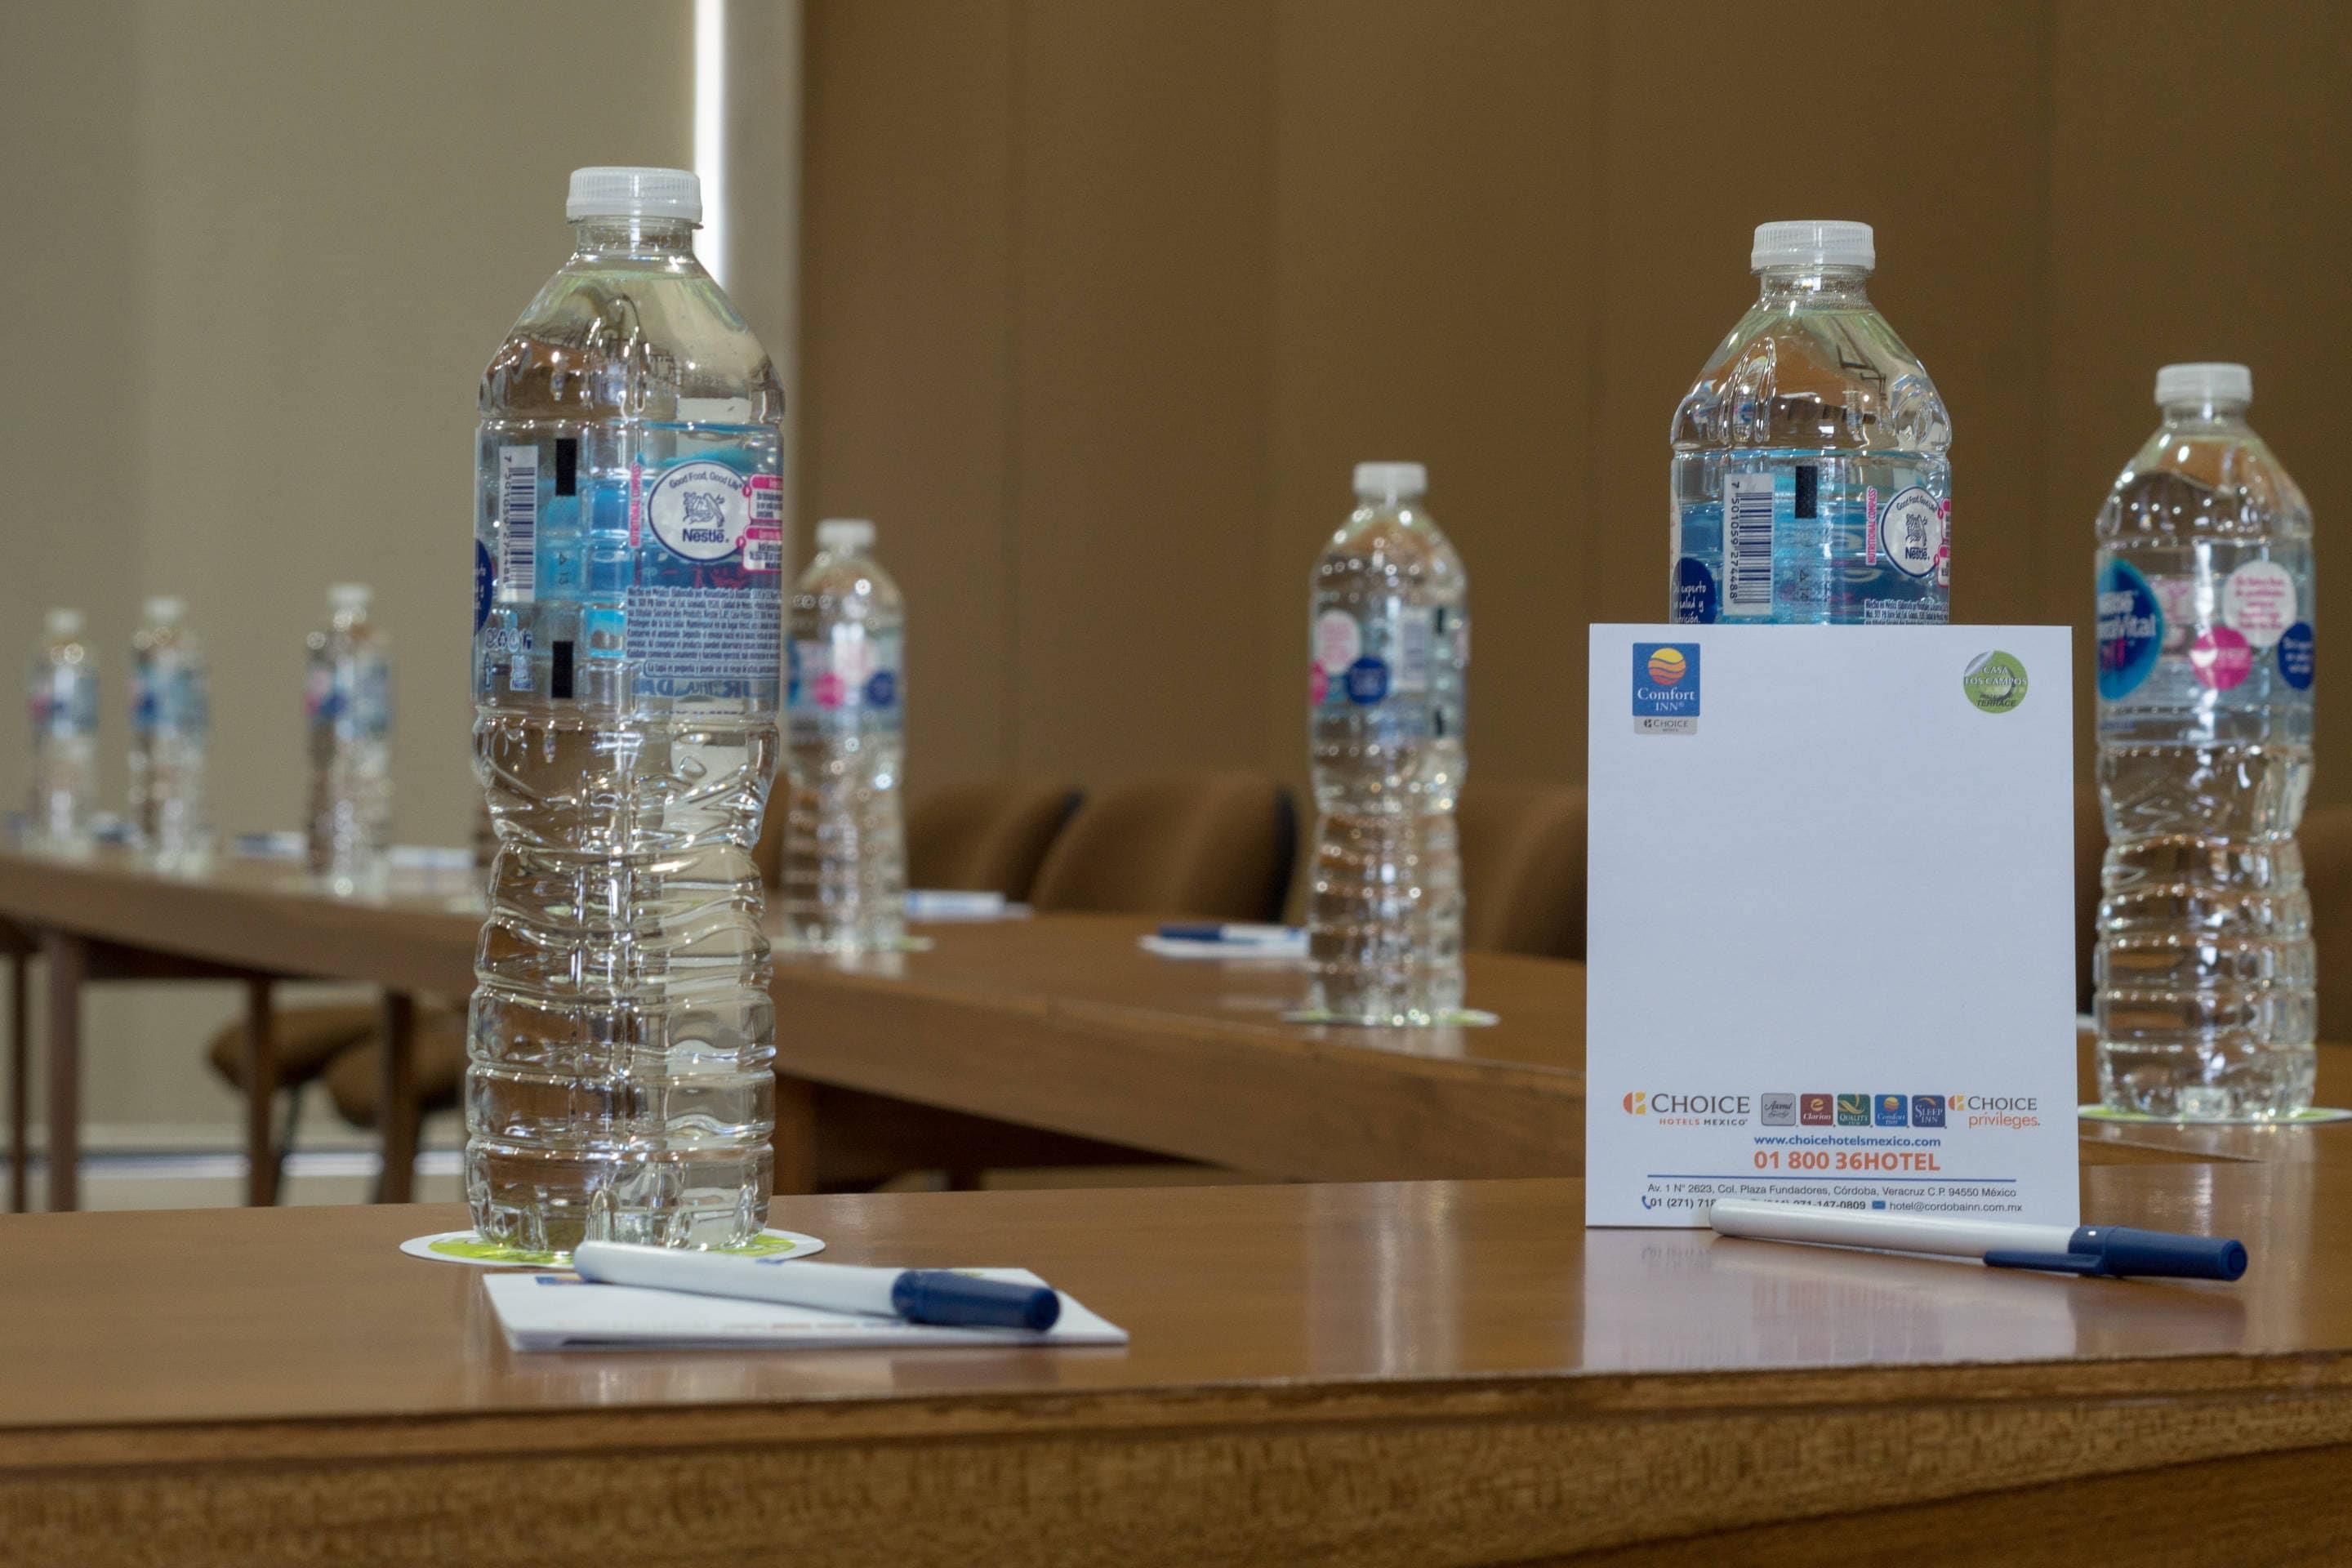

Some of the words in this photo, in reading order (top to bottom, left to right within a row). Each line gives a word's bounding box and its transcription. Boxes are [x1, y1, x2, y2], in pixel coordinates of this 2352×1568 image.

[669, 475, 688, 488] Good
[710, 471, 728, 484] Good
[1731, 497, 1740, 546] 501059
[1730, 551, 1739, 599] 274488
[1681, 581, 1707, 597] experto
[1699, 600, 1704, 613] y
[1965, 677, 1983, 685] LOS
[1985, 677, 2026, 685] CAMPOS
[1637, 687, 1695, 701] Comfort
[1653, 719, 1689, 728] CHOICE
[1651, 1093, 1750, 1114] CHOICE
[1968, 1096, 2038, 1111] CHOICE
[1802, 1113, 1831, 1121] Clarion
[1914, 1104, 1943, 1117] SLEEP
[1839, 1113, 1869, 1122] QUALITY
[1921, 1116, 1939, 1124] INN
[1754, 1134, 1941, 1147] www.choicehotelsmexico.com
[1754, 1151, 1780, 1169] 01
[1788, 1152, 1829, 1169] 800
[1836, 1152, 1941, 1171] 36HOTEL
[1666, 1184, 1670, 1192] 1
[1688, 1184, 1714, 1193] 2623,
[1717, 1184, 1735, 1193] Col.
[1740, 1185, 1766, 1194] Plaza
[1770, 1185, 1831, 1196] Fundadores,
[1833, 1186, 1878, 1196] Córdoba,
[1882, 1187, 1924, 1196] Veracruz
[1949, 1187, 1979, 1196] 94550
[1981, 1187, 2016, 1197] México
[1650, 1198, 1662, 1207] 01
[1667, 1198, 1694, 1209] (271)
[1889, 1201, 2023, 1213] hotel@cordobainn.com.mx
